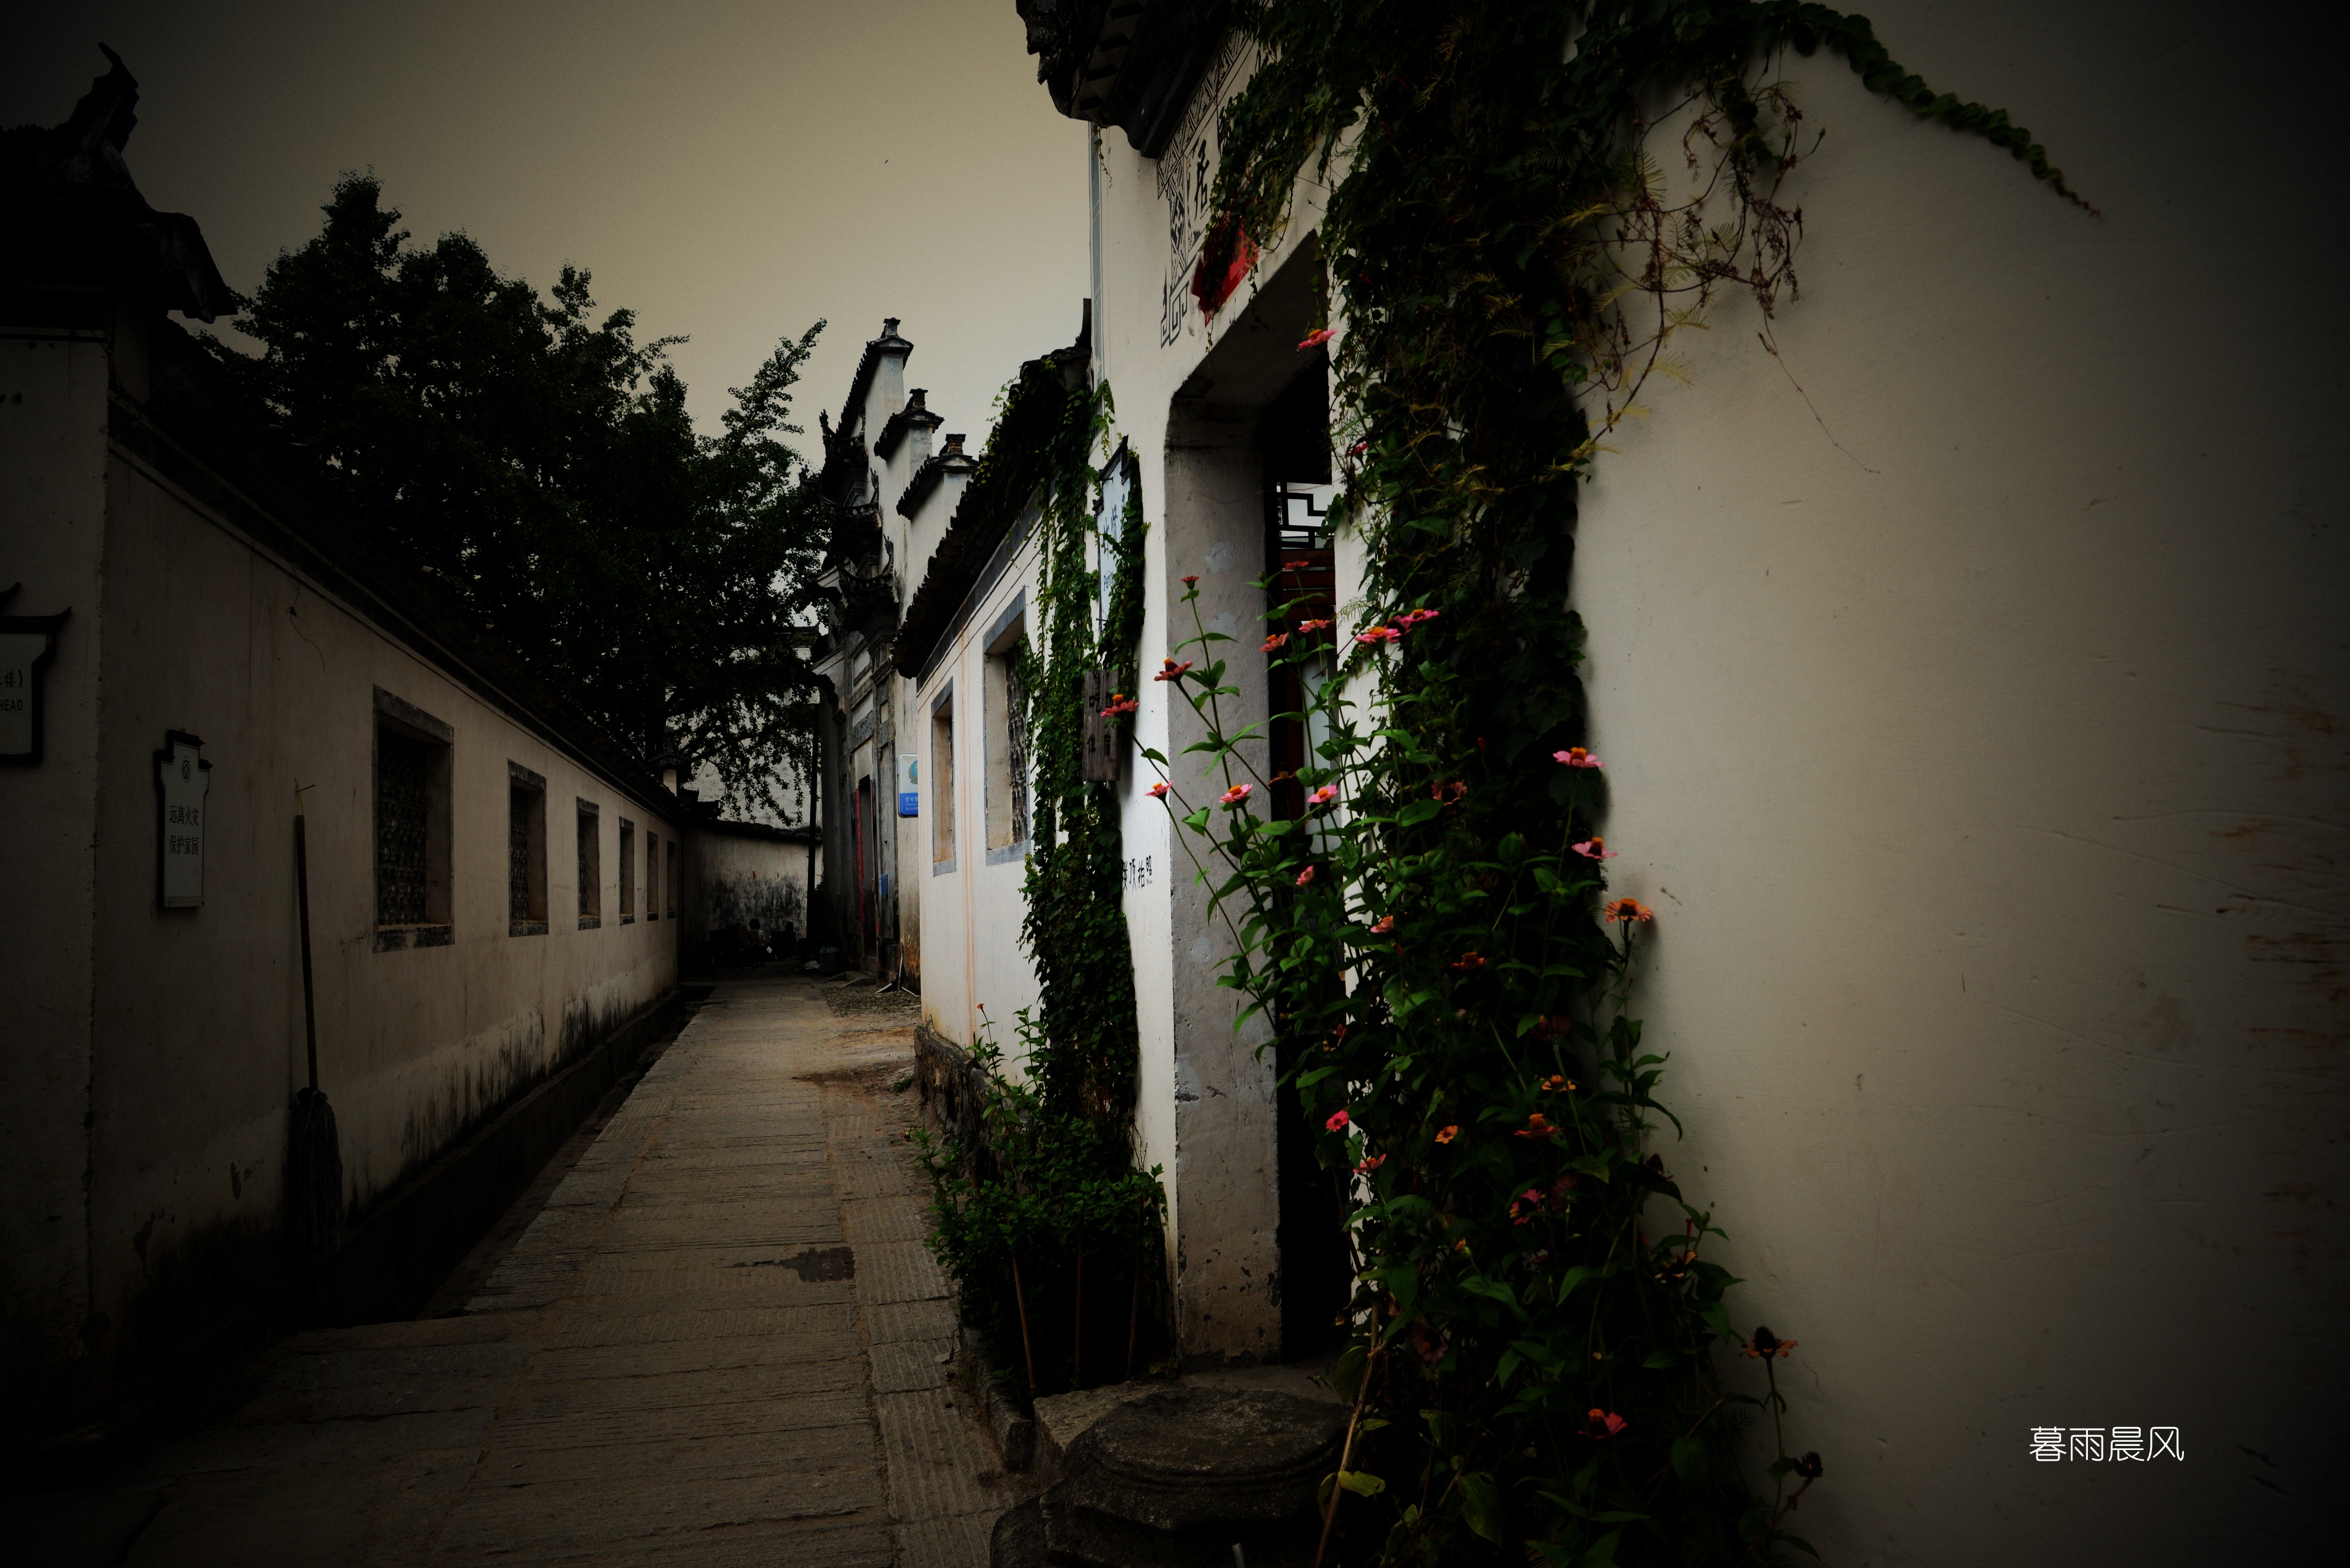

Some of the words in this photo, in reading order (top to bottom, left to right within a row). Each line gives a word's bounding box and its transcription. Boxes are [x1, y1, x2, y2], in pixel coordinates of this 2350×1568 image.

[1087, 732, 1111, 756] 住宿
[170, 804, 199, 826] 远离火灾
[170, 834, 199, 855] 保护家园
